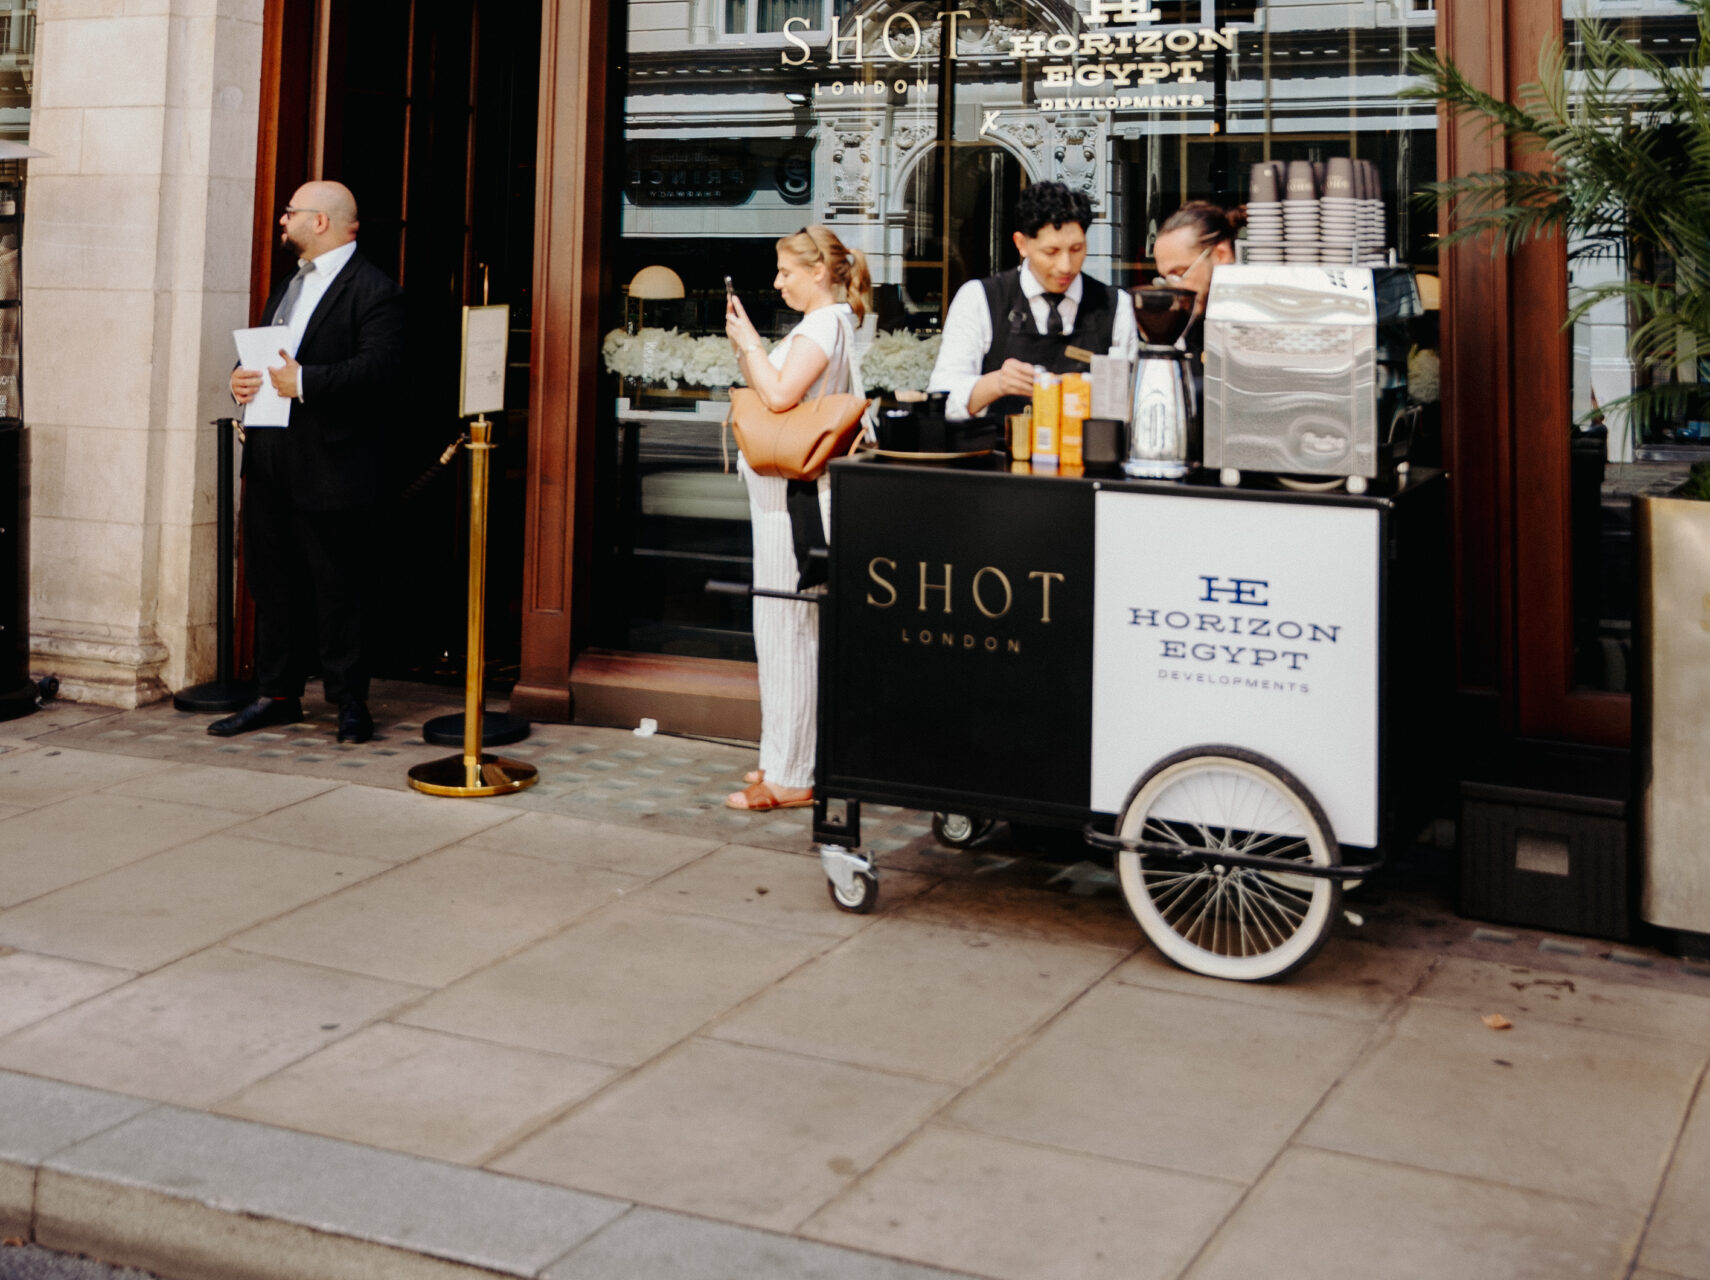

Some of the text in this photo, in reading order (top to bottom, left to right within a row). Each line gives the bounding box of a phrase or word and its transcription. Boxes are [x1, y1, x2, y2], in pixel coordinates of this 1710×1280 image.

[781, 10, 971, 66] SHOT
[1009, 27, 1239, 57] HORIZON
[814, 79, 929, 96] LONDON
[1042, 61, 1204, 87] EGYPT
[1040, 94, 1205, 111] DEVELOPMENTS
[867, 557, 1065, 623] SHOT
[1128, 607, 1341, 644] HORIZON
[901, 628, 1020, 653] LONDON
[1160, 639, 1309, 670] EGYPT
[1158, 669, 1310, 694] DEVELOPMENTS
